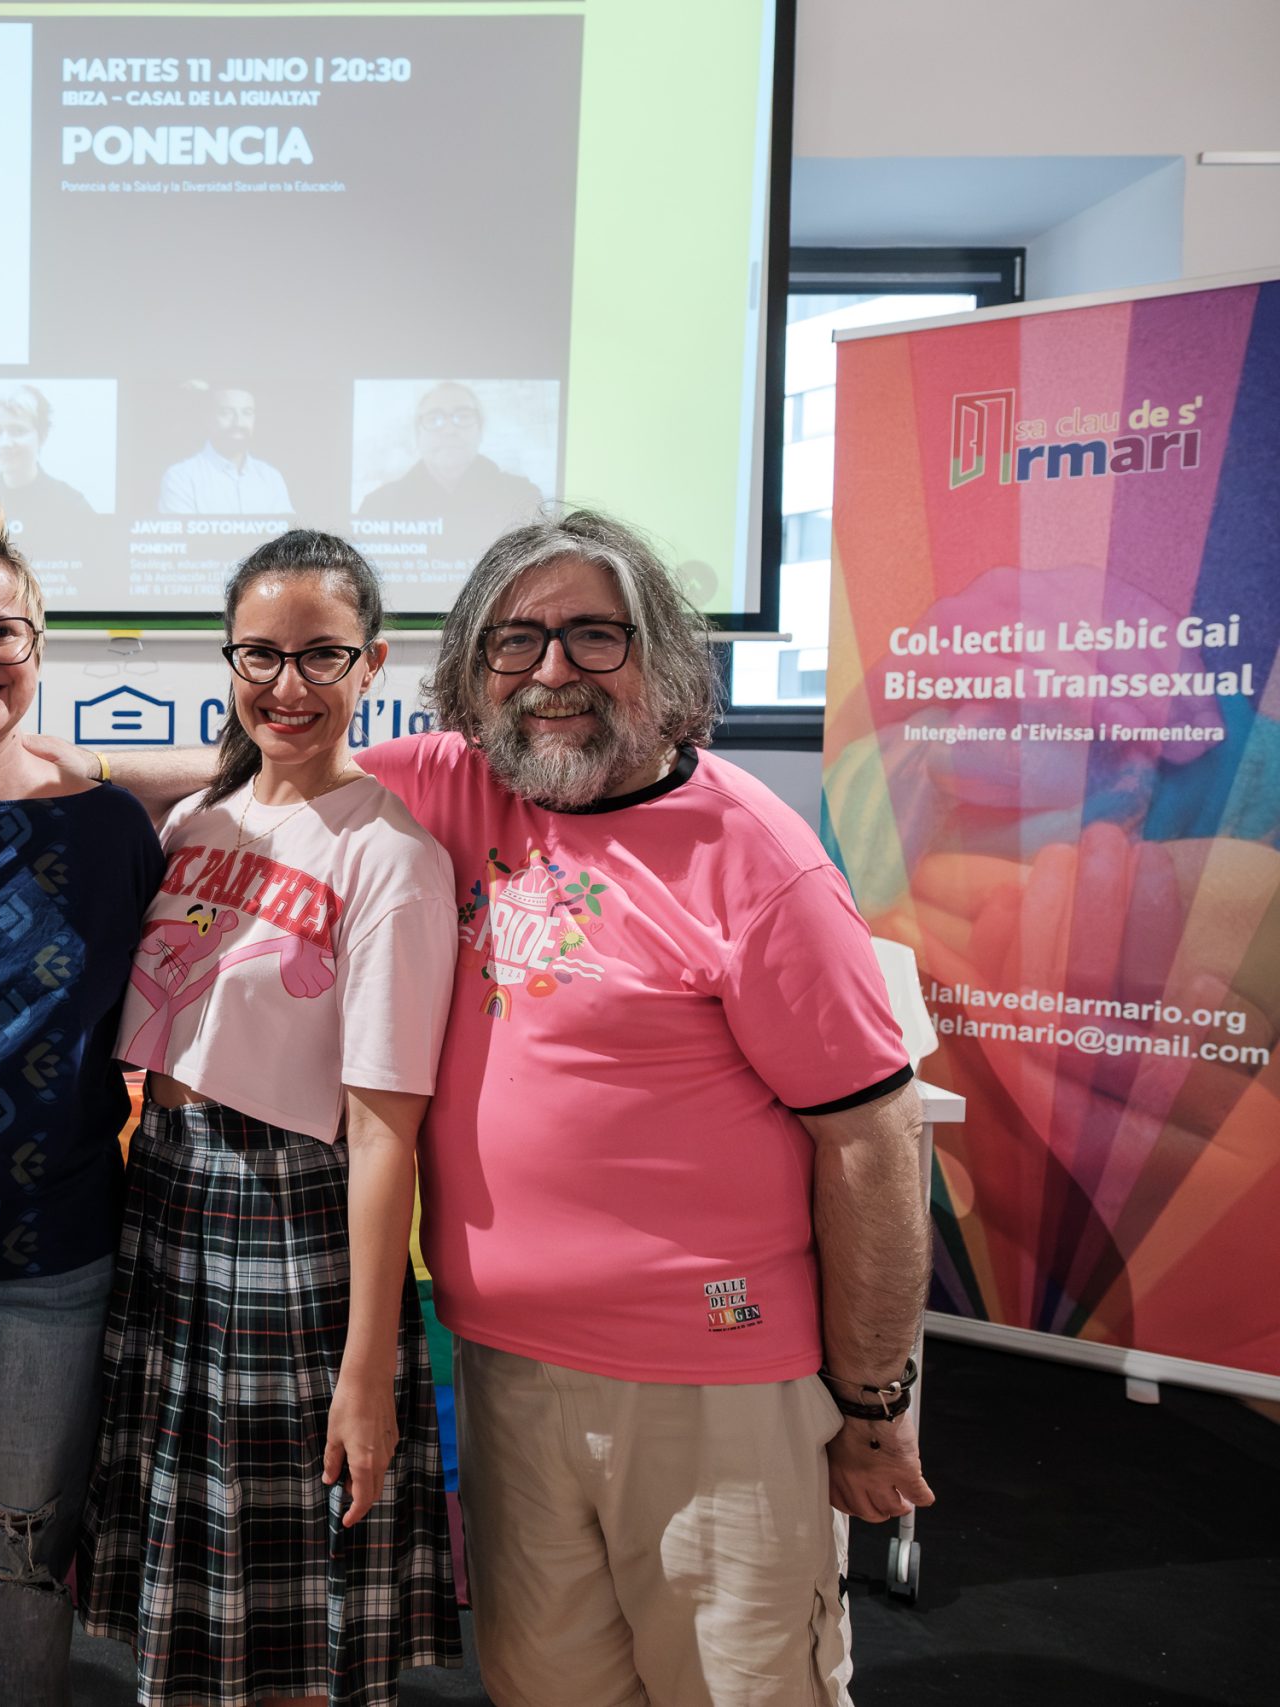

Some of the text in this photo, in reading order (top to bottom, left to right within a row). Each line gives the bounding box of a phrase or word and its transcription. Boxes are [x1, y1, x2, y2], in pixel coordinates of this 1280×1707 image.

[63, 57, 178, 82] MARTES
[186, 57, 210, 82] 11
[218, 57, 308, 82] JUNIO
[330, 57, 411, 82] 20:30
[62, 90, 107, 106] IBIZA
[126, 90, 184, 106] CASAL
[188, 90, 210, 106] DE
[214, 90, 237, 106] LA
[240, 90, 320, 106] IGUALTAT
[62, 126, 314, 165] PONENCIA
[61, 180, 105, 192] Ponencia
[108, 180, 120, 192] de
[134, 180, 161, 192] Salud
[182, 180, 232, 192] Diversidad
[234, 180, 267, 192] Sexual
[294, 180, 346, 192] Educación
[1016, 419, 1046, 440] sa
[1056, 407, 1119, 436] clau
[1128, 399, 1169, 430] de
[1016, 429, 1201, 484] rmari
[130, 520, 289, 534] JAVIER SOTOMAYOR
[350, 517, 443, 535] TONI MARTÍ
[129, 542, 187, 554] PONENTE
[1057, 618, 1167, 652] Lèsbic
[1176, 614, 1240, 649] Gai
[884, 663, 1254, 701] Bisexual Transsexual
[904, 723, 1006, 744] Intergènere
[1099, 724, 1106, 742] i
[1111, 723, 1224, 743] Formentera
[474, 901, 561, 970] PRIDE
[920, 980, 1246, 1035] .lallavedelarmario.org
[705, 1278, 746, 1295] CALLE
[710, 1294, 746, 1308] DE LA
[708, 1305, 760, 1324] VIRGEN
